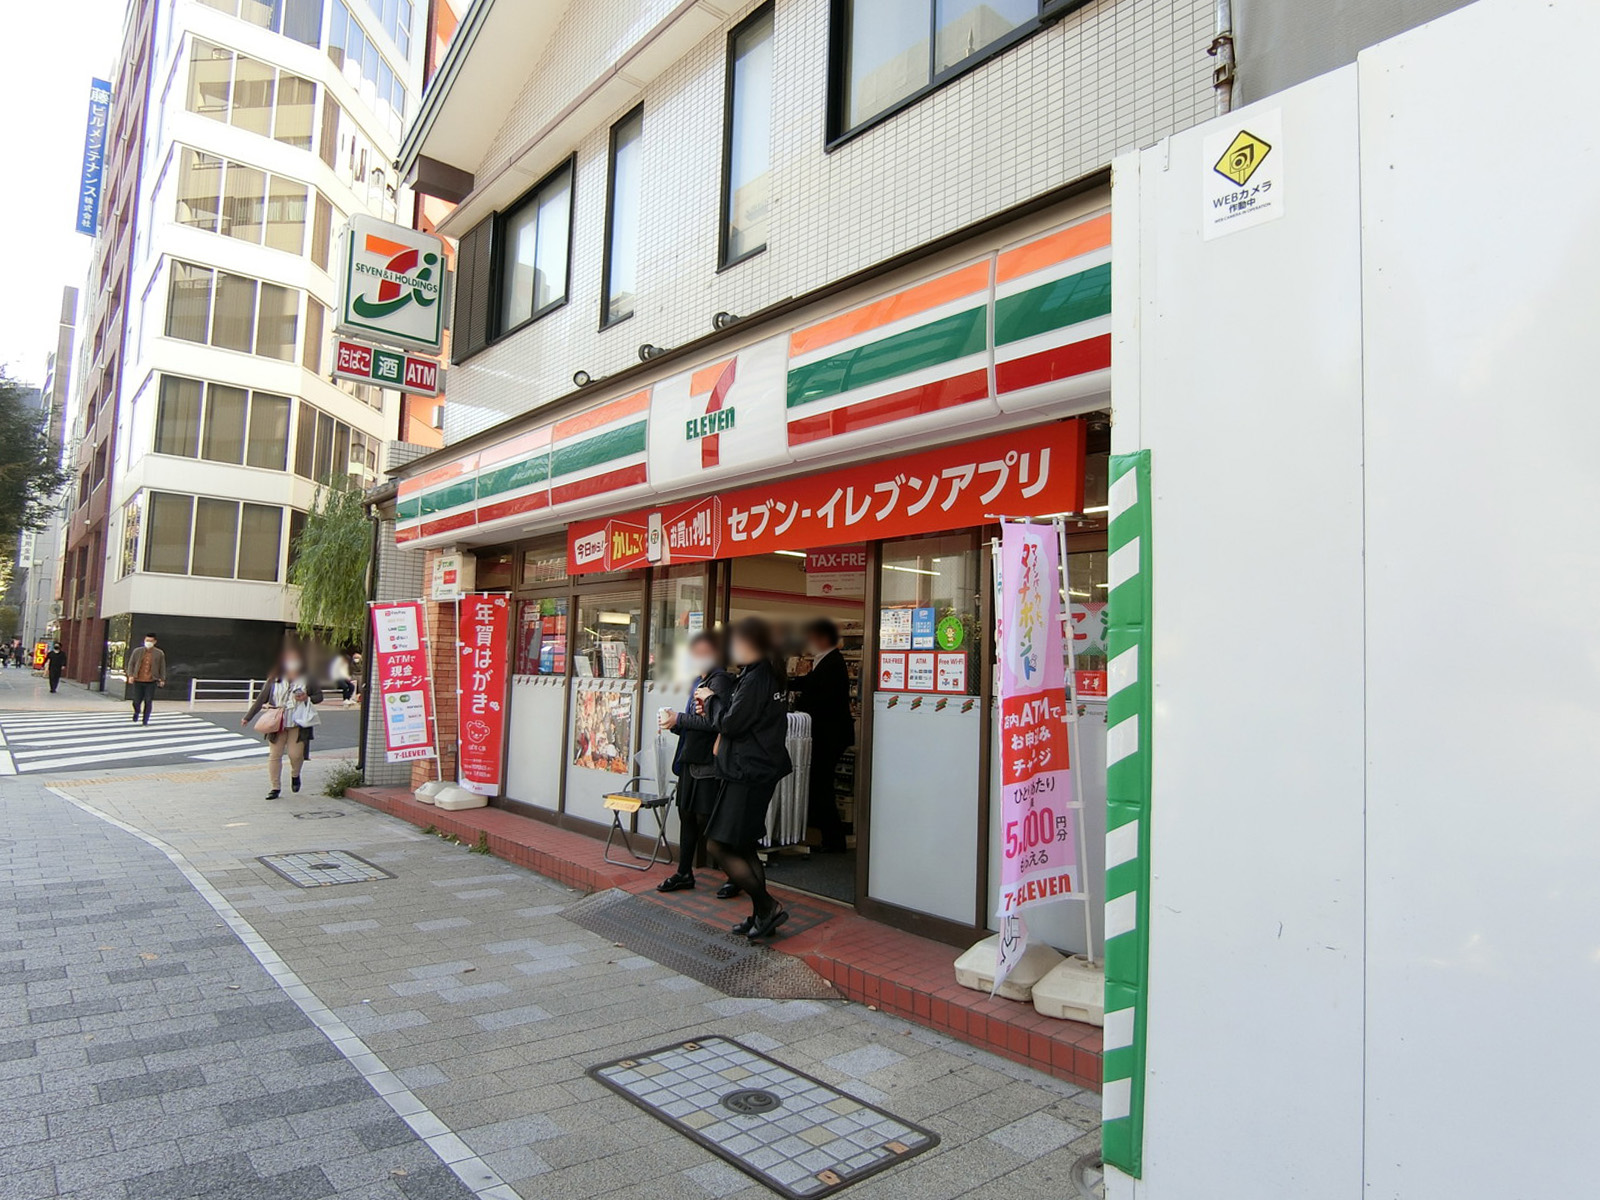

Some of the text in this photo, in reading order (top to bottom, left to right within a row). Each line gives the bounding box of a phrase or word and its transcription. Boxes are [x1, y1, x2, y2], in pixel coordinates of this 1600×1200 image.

[1213, 180, 1272, 209] WEBカメラ
[1229, 198, 1256, 214] 作動中
[394, 274, 438, 293] HOLDINGS
[338, 347, 436, 387] たばこ 酒 ATM
[612, 531, 644, 561] かしこく
[810, 553, 866, 568] TAX-FRE
[388, 655, 416, 665] ATMで
[472, 603, 495, 715] 年賀はがき
[915, 657, 927, 665] ATM
[390, 665, 414, 678] 現金
[383, 677, 422, 690] チャージ
